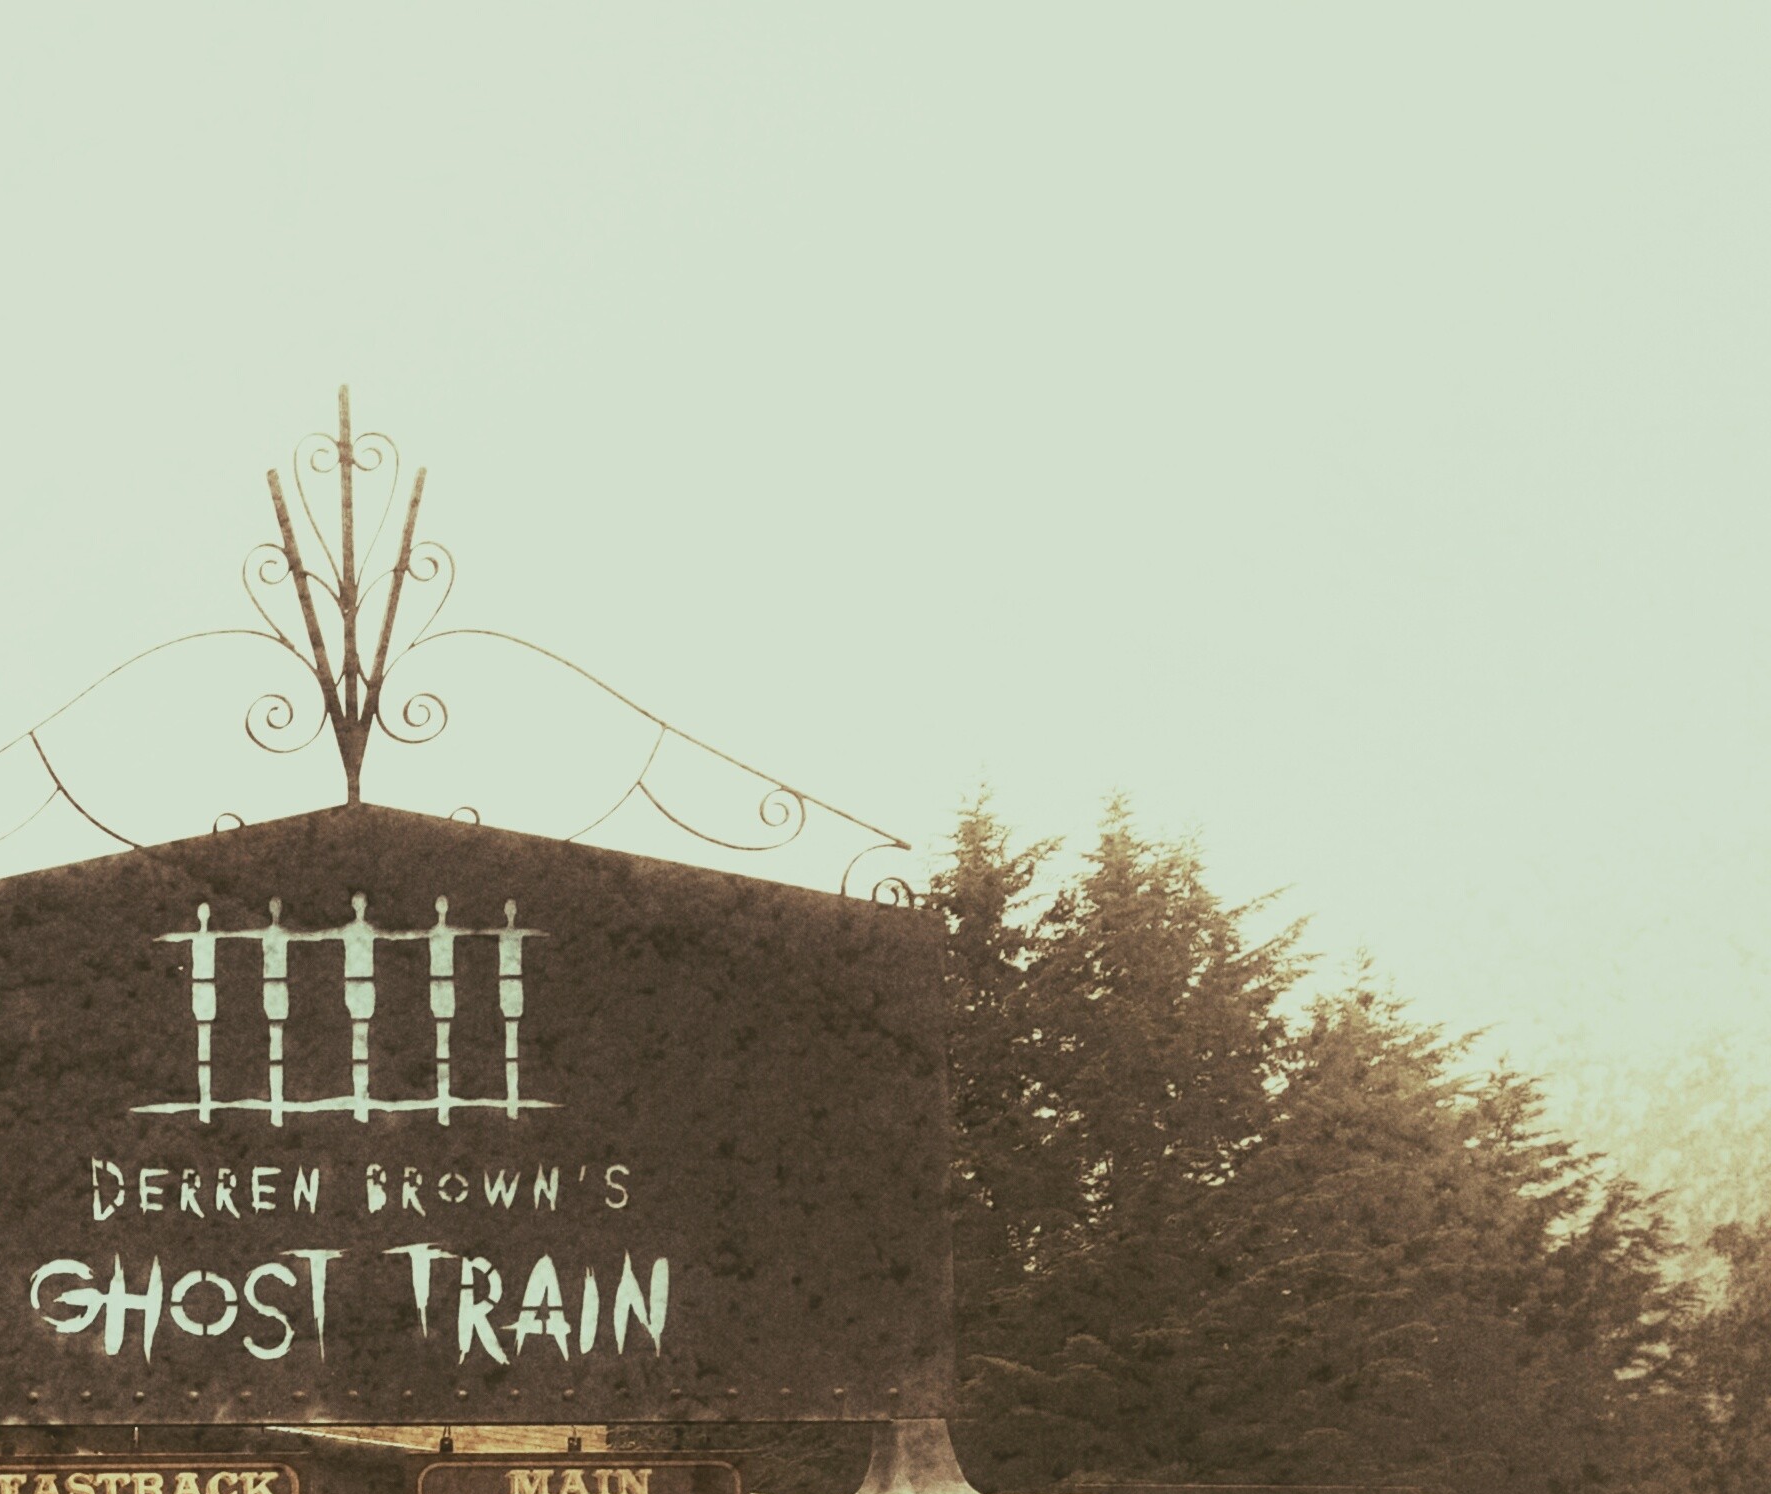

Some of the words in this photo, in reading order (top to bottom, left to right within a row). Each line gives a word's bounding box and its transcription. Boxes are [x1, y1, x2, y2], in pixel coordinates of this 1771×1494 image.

[92, 1157, 321, 1222] DERREN
[365, 1161, 632, 1215] BROWN'S
[29, 1247, 344, 1364] GHOST
[382, 1242, 670, 1366] TRAIN
